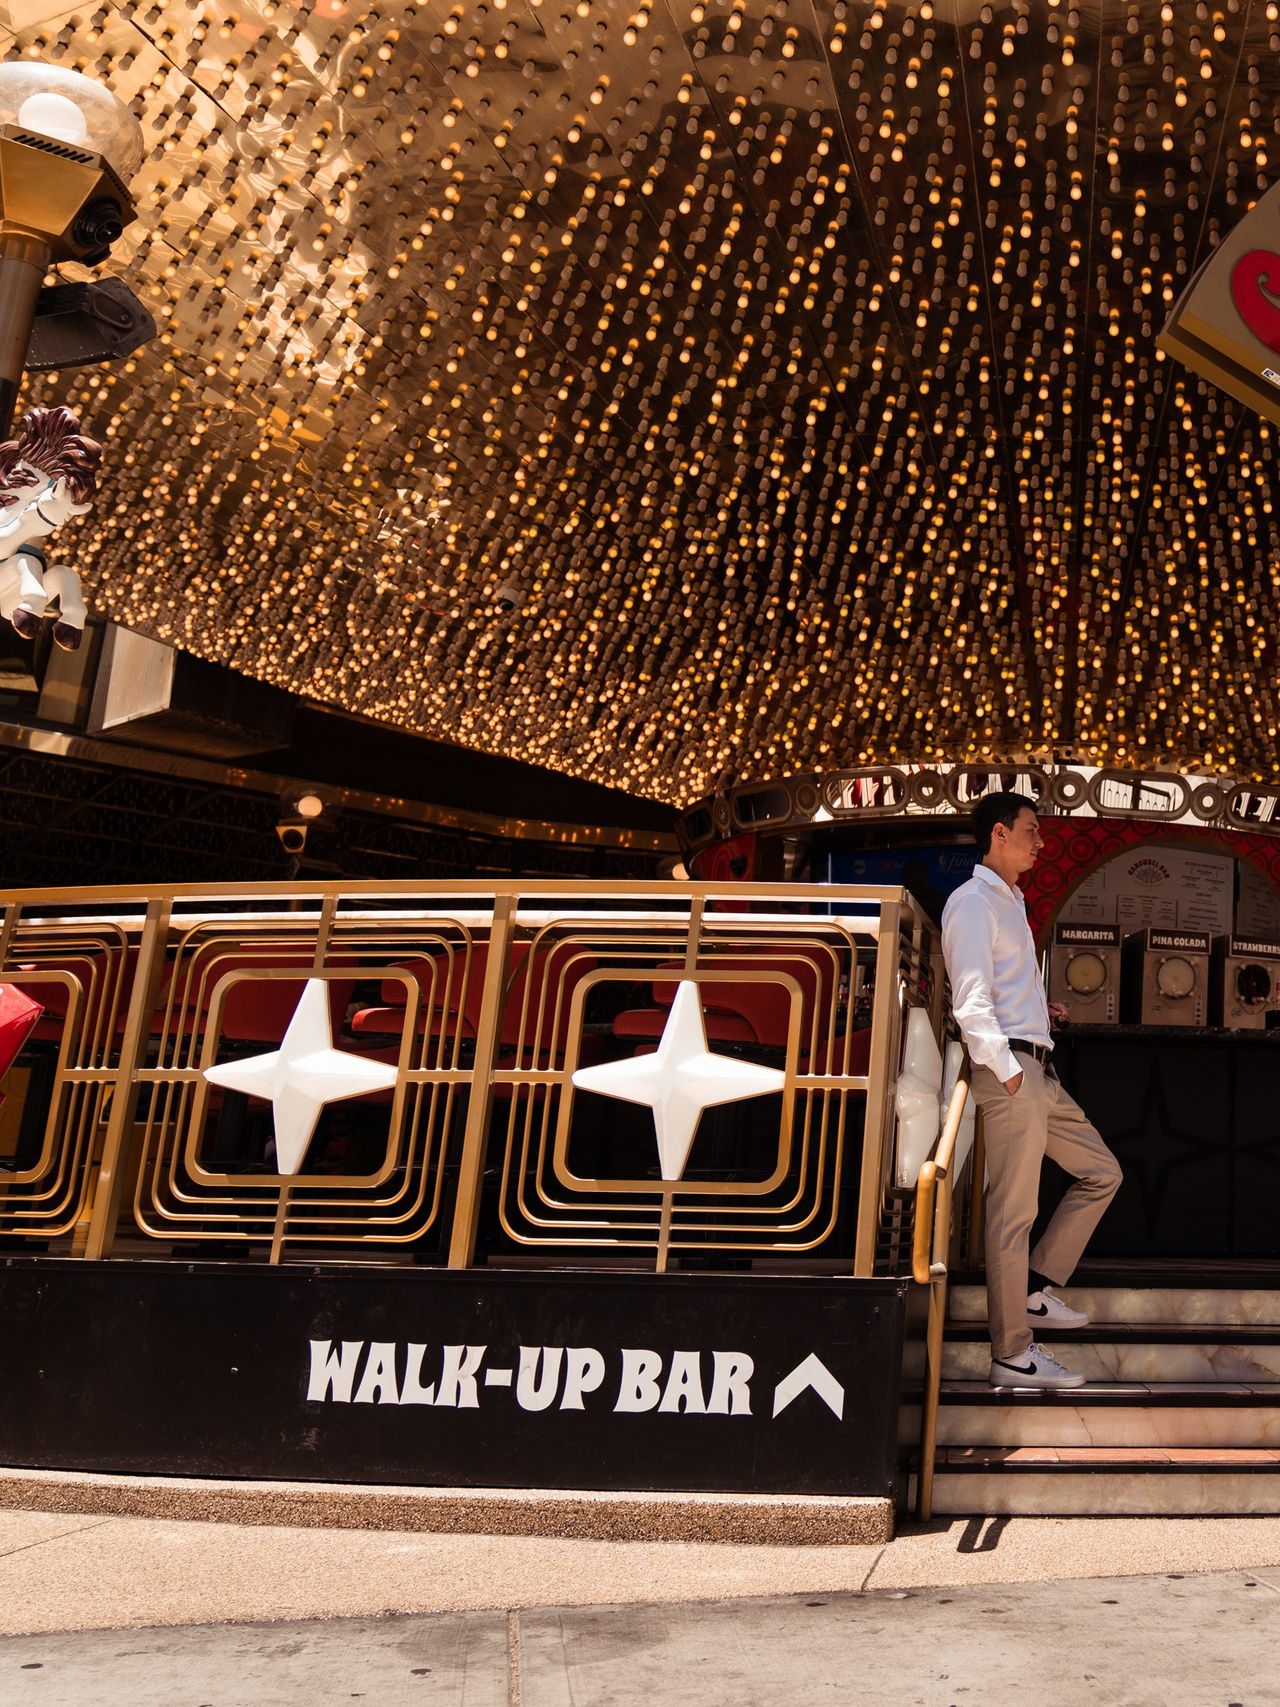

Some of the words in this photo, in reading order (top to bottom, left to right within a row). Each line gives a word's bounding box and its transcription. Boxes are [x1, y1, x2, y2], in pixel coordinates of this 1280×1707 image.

[945, 852, 982, 874] Final
[1128, 858, 1159, 876] CAROUSEL
[1159, 865, 1171, 879] BAR
[1062, 929, 1115, 941] MARGARITA
[1152, 935, 1173, 946] PINA
[1174, 936, 1207, 948] COLADA
[306, 1339, 606, 1412] WALK-UP
[612, 1348, 755, 1416] BAR
